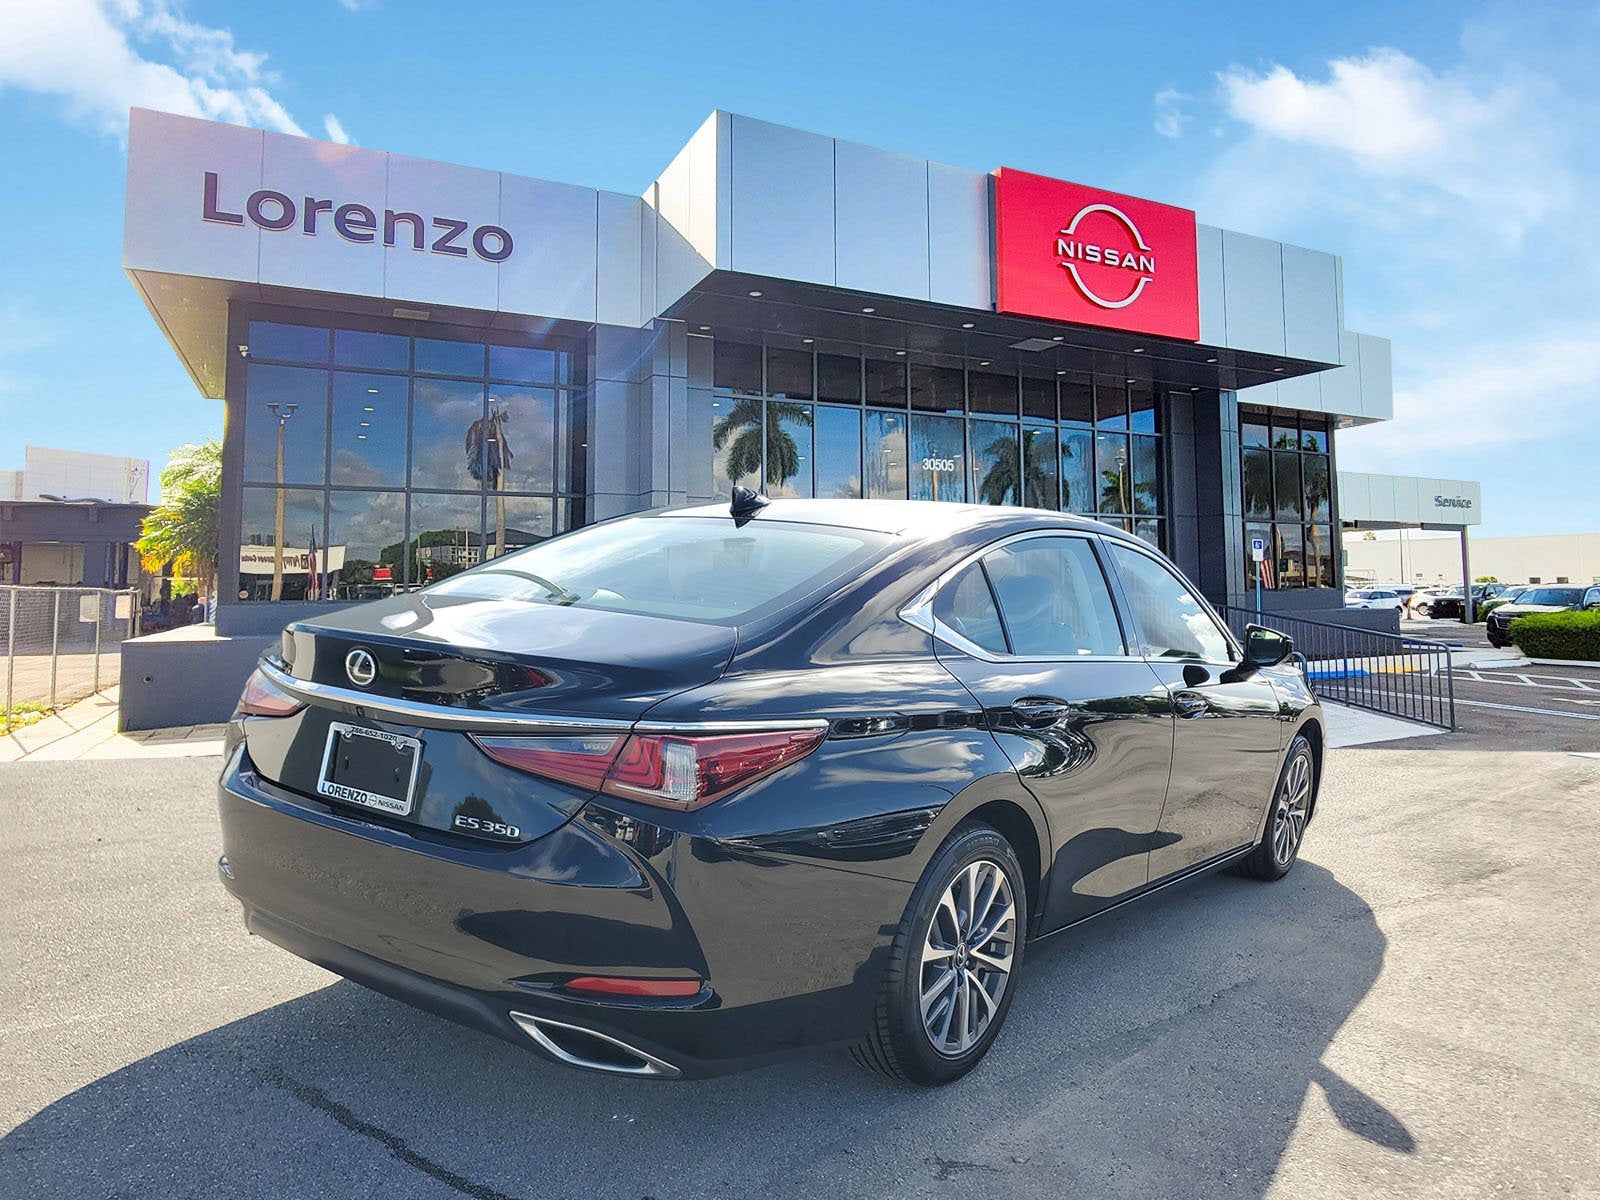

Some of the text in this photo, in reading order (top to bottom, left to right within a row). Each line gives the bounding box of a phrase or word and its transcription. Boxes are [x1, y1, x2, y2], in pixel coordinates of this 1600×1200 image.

[202, 171, 514, 262] Lorenzo
[1057, 238, 1156, 273] NISSAN
[922, 458, 955, 472] 30505
[1434, 495, 1472, 509] Service
[321, 782, 405, 812] LORENZO NISSAN
[454, 814, 520, 838] ES 350
